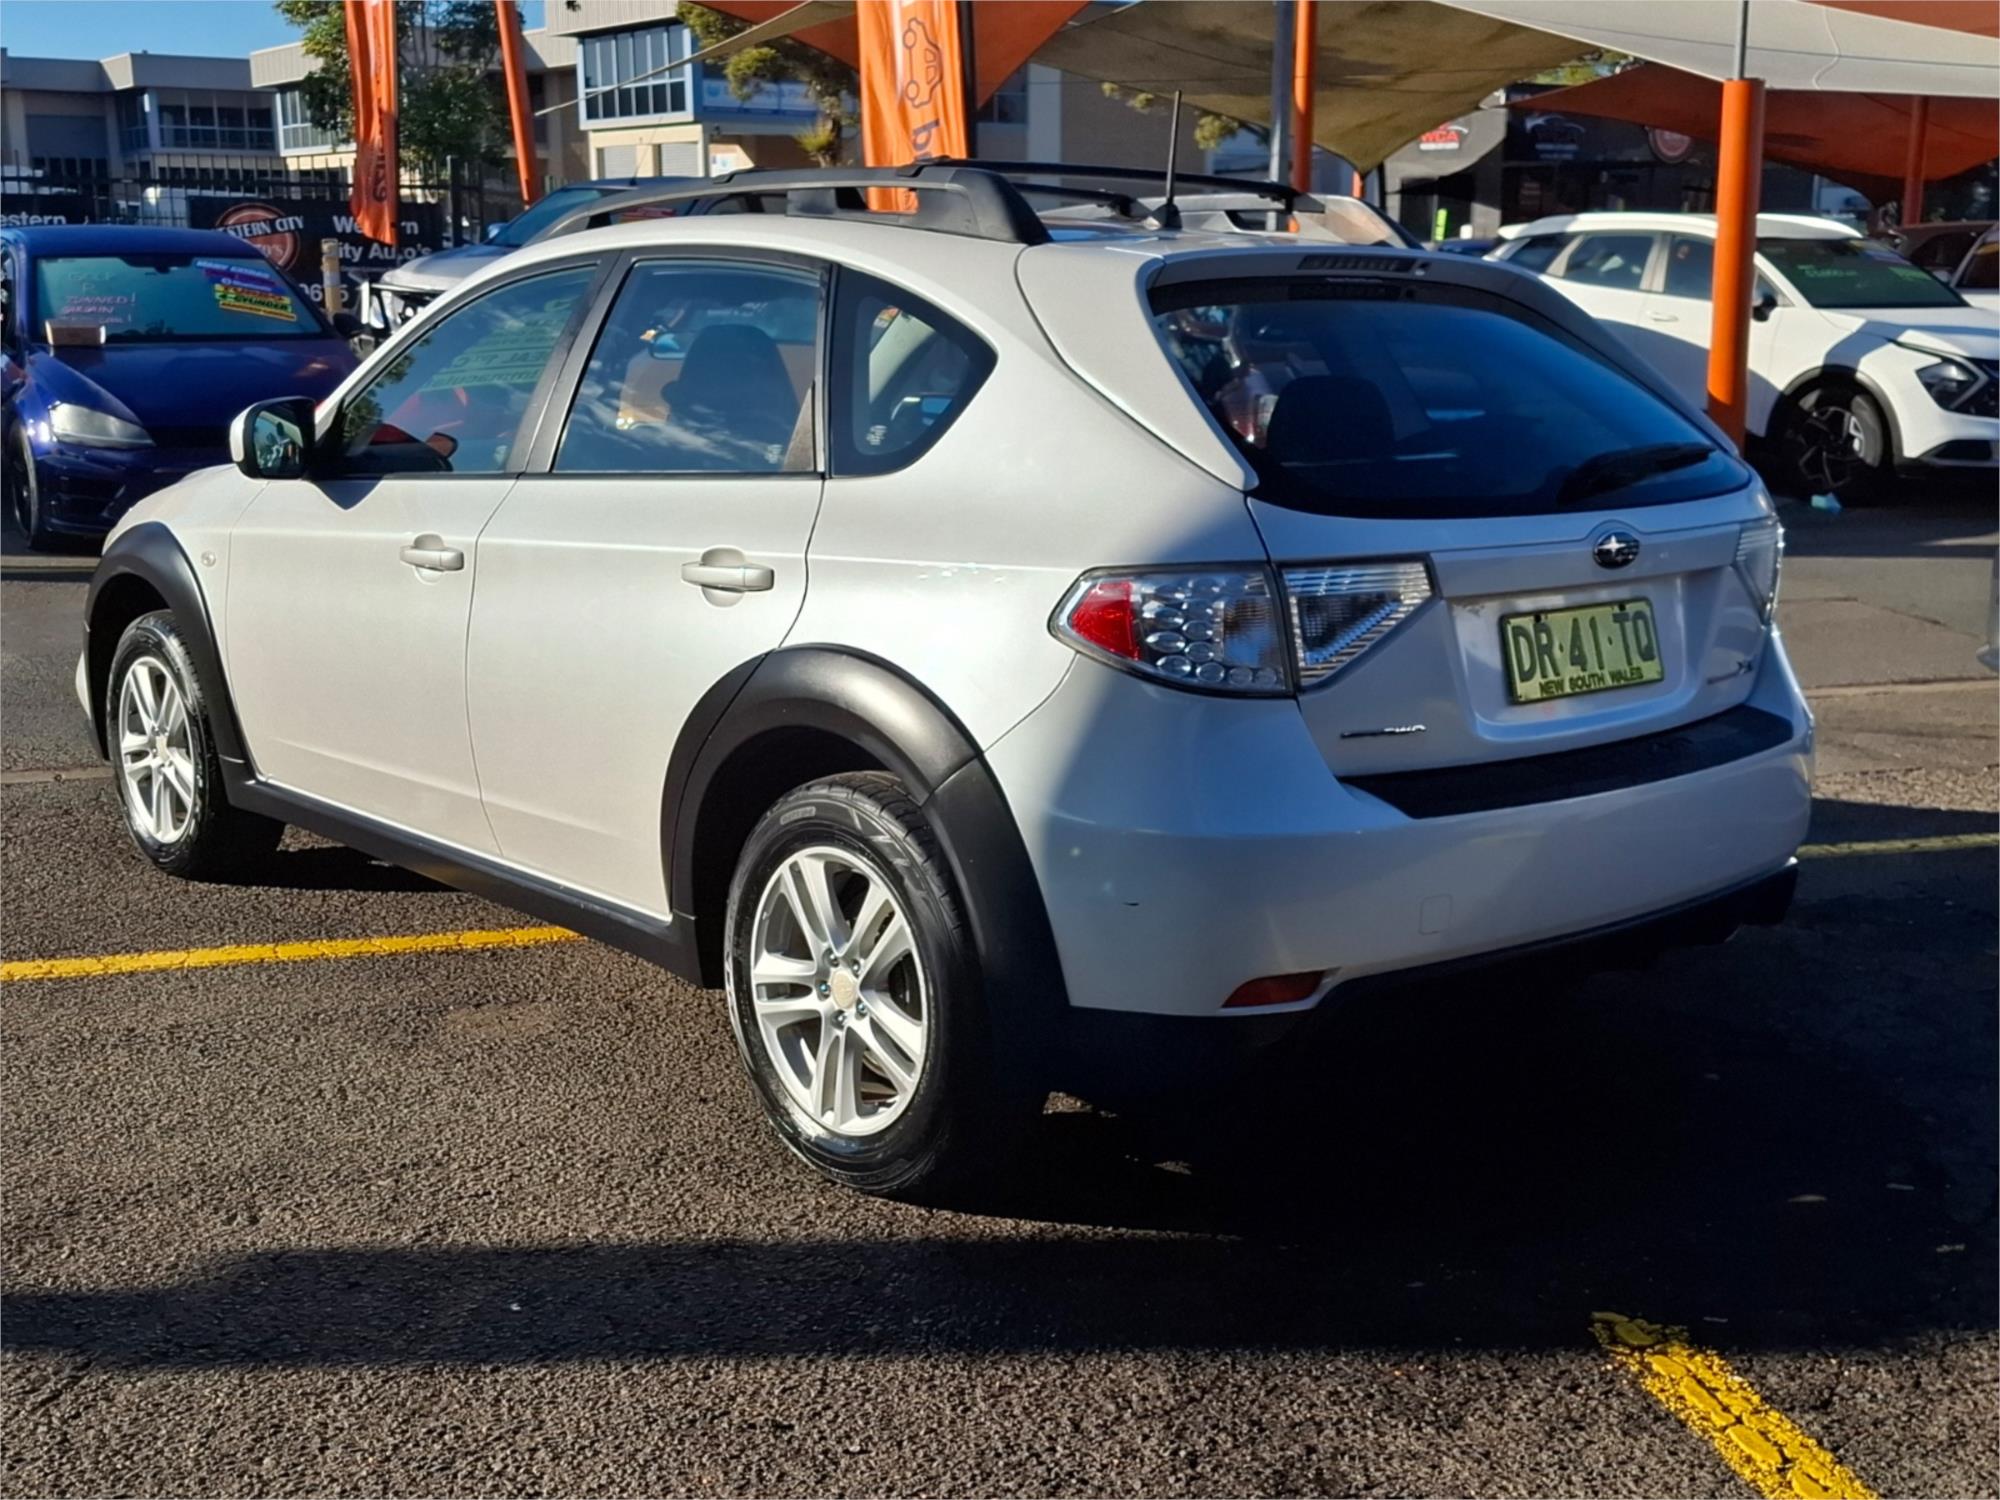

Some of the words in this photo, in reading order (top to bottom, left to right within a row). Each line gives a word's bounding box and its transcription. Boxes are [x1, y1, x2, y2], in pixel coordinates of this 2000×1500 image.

[275, 216, 304, 232] CITY
[338, 242, 363, 263] ity
[368, 243, 432, 260] Auo's
[1539, 678, 1565, 697] NEW
[1568, 674, 1606, 692] SOUTH
[1609, 667, 1644, 684] WALES
